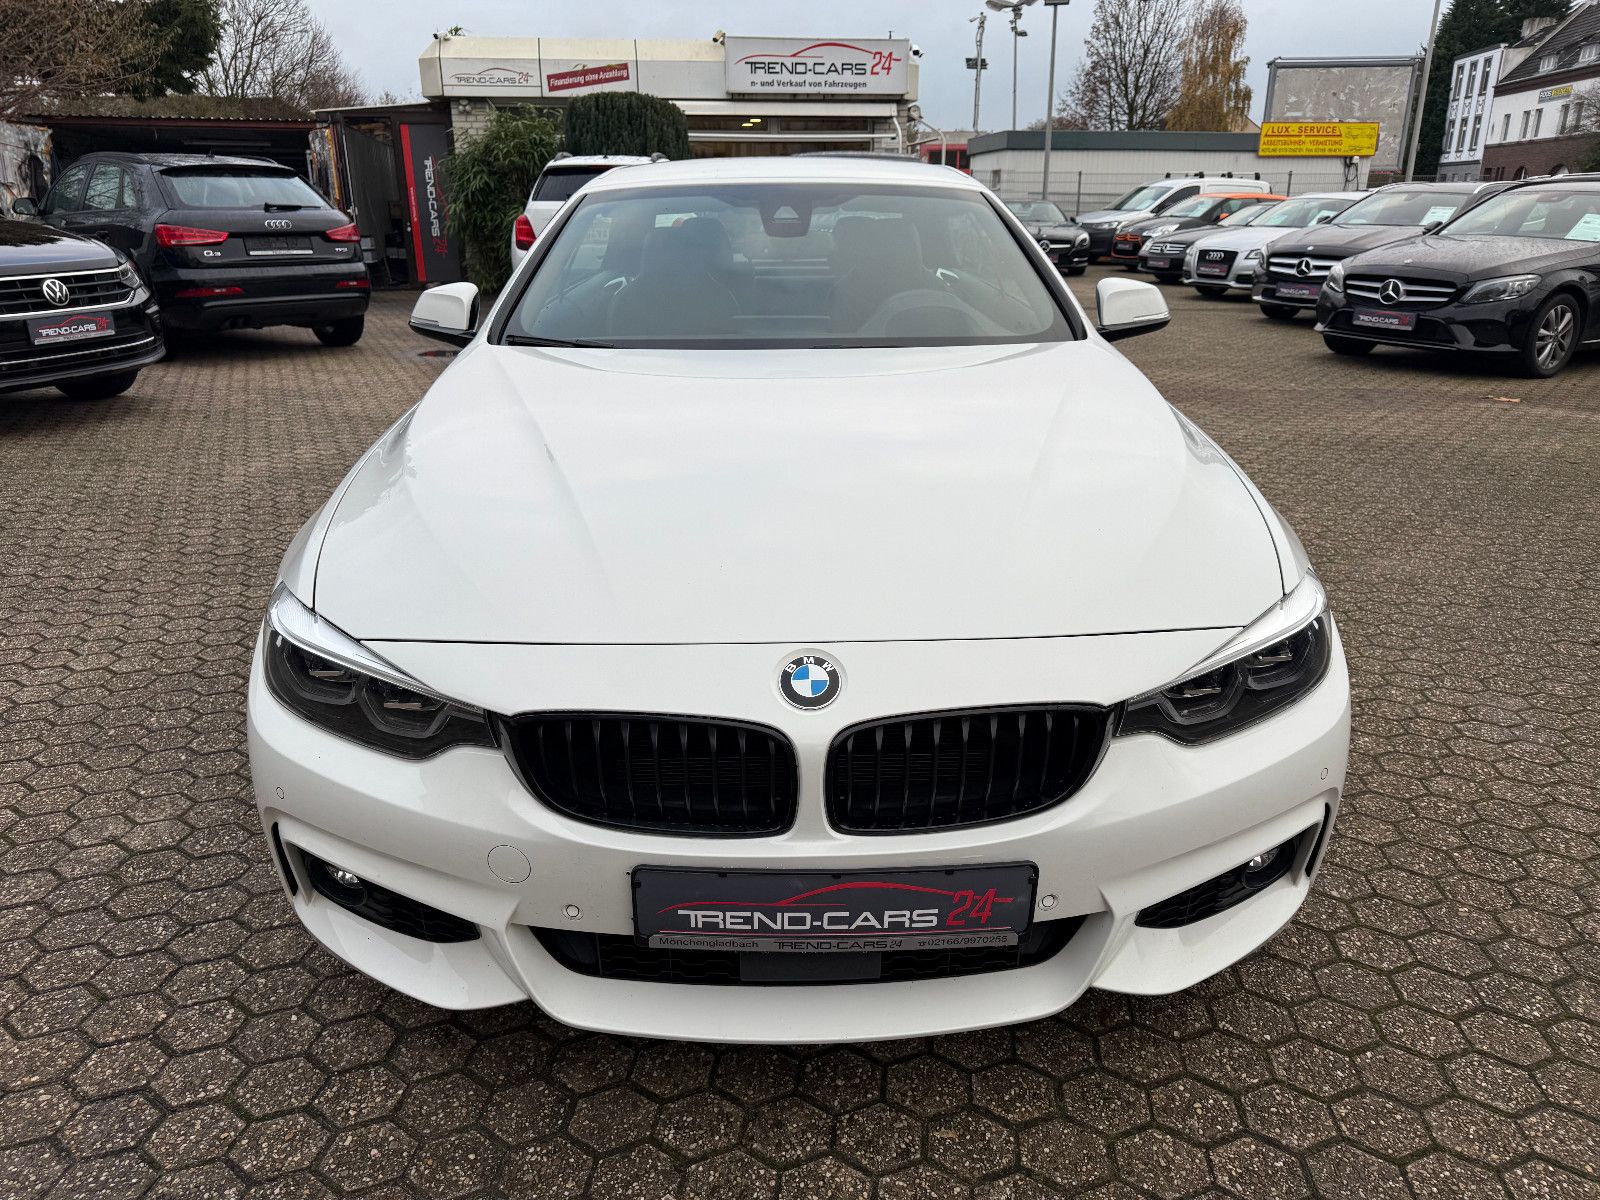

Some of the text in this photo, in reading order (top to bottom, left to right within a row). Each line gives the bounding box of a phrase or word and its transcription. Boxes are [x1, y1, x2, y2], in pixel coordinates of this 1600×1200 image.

[745, 51, 893, 76] TREND-CARS 24
[455, 72, 529, 84] TREND-CARS 24
[550, 68, 628, 87] Finanzierung ohne Anzahlung
[776, 80, 806, 88] Verkauf
[824, 80, 867, 90] Fahrzeugen
[1271, 125, 1290, 134] LUX
[1297, 125, 1338, 134] SERVICE
[424, 155, 440, 237] TREND-CARS
[1359, 314, 1400, 325] TREND-CARS
[39, 323, 97, 336] TREND-CARS
[785, 656, 834, 673] BMW
[677, 888, 997, 930] TREND-CARS 24
[659, 936, 760, 950] Mönchengladbach
[773, 940, 888, 950] TREND-CARS
[890, 939, 903, 949] 24
